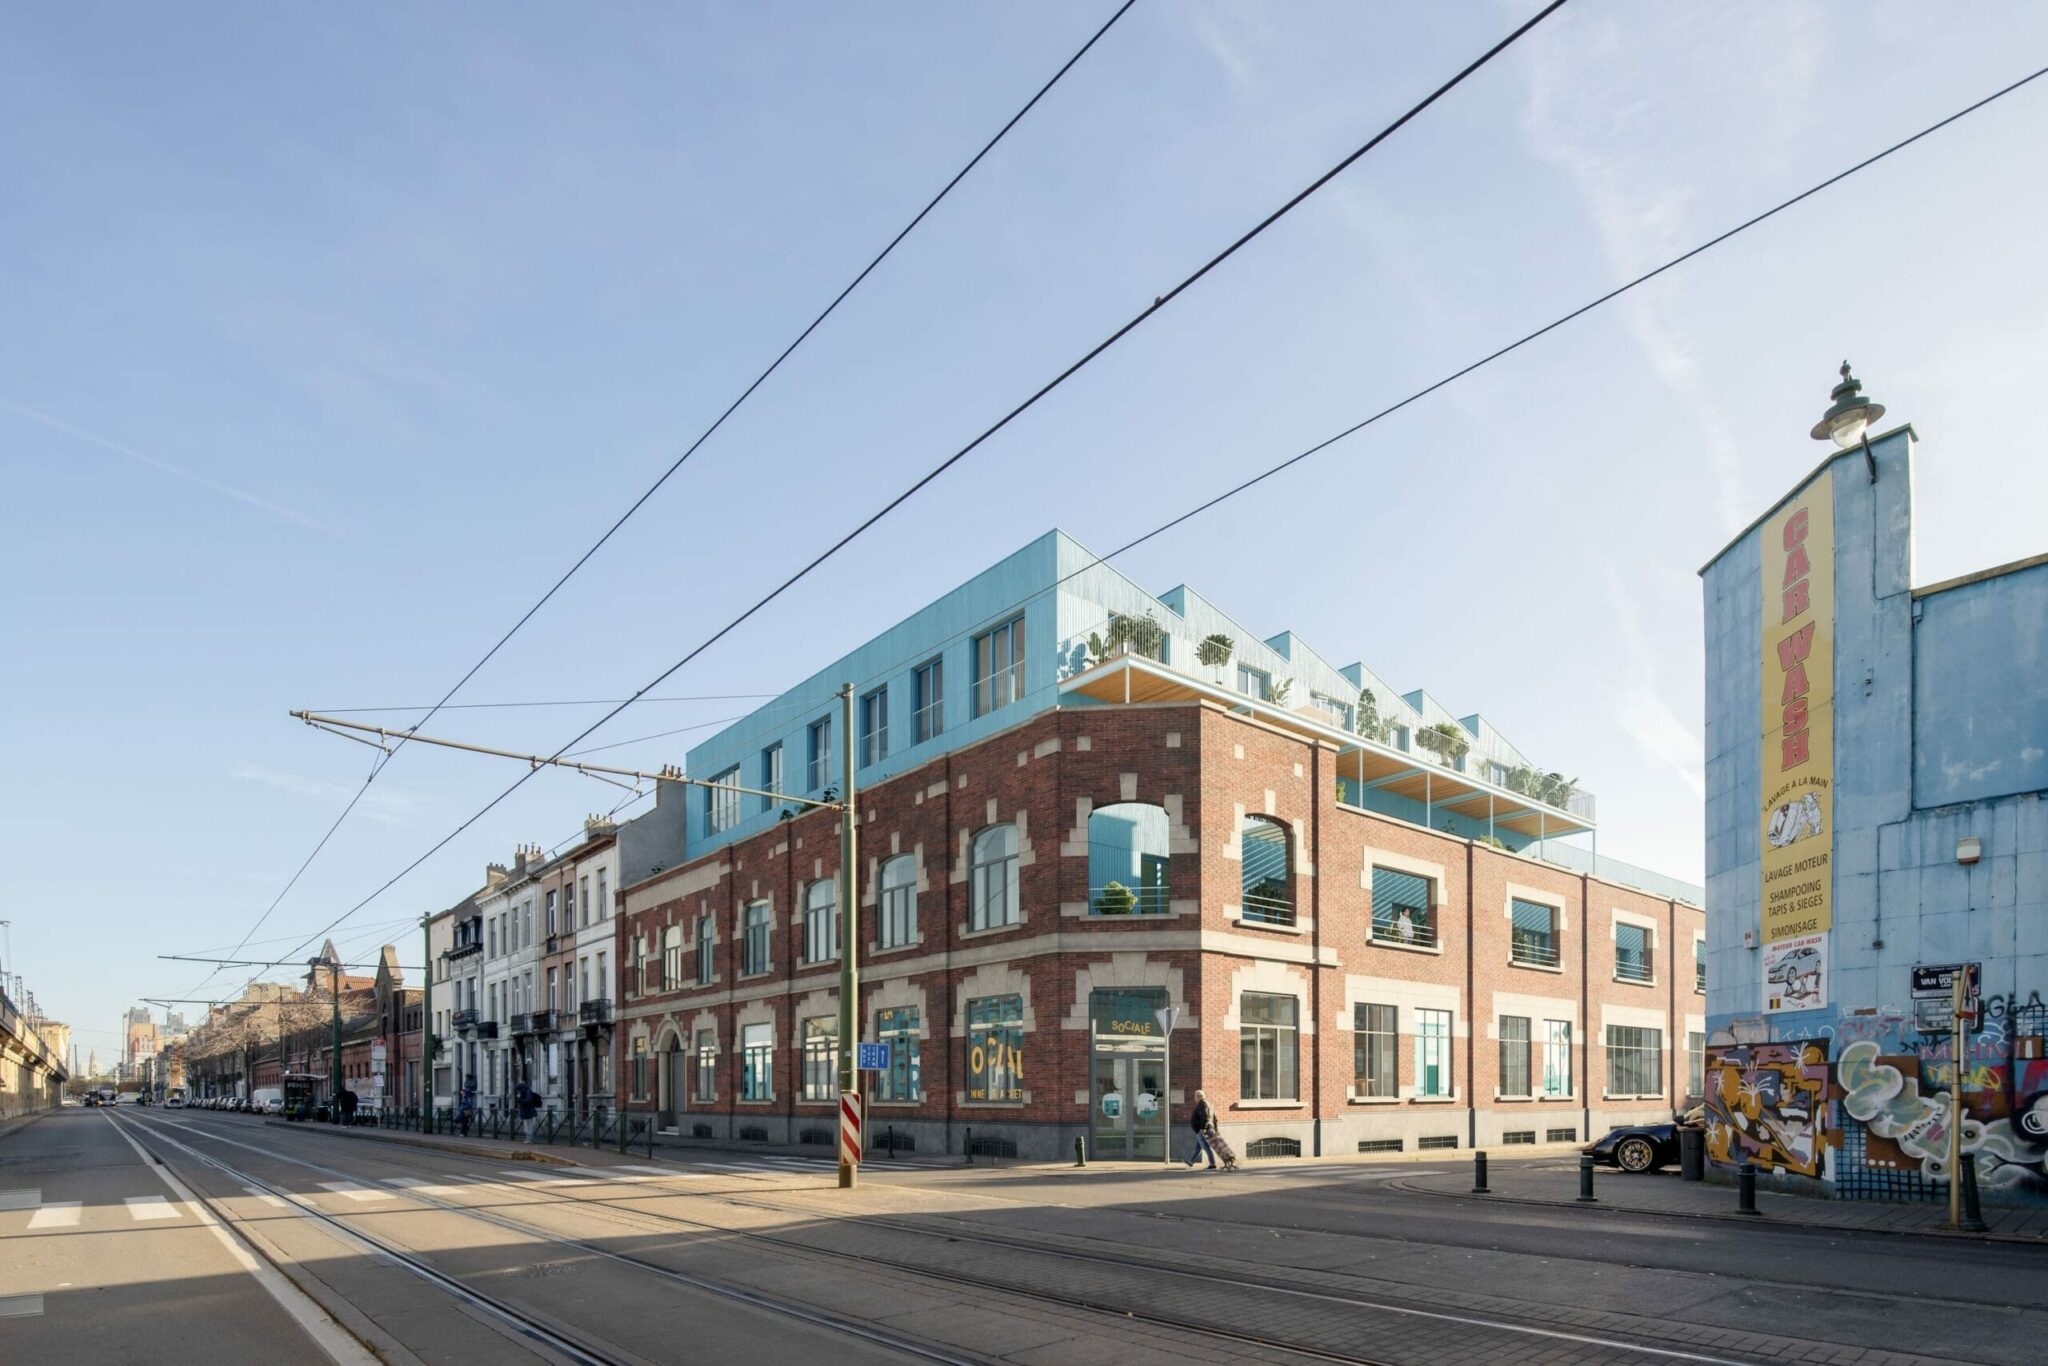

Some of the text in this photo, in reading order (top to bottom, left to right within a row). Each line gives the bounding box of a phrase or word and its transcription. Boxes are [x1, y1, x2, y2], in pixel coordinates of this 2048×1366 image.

[1777, 507, 1815, 772] CAR WASH
[1763, 783, 1791, 812] LAVAGE
[1798, 777, 1808, 787] LA
[1809, 775, 1829, 789] MAIN
[1765, 853, 1828, 883] LAVAGE MOTEUR
[1769, 879, 1822, 904] SHAMPOOING
[1768, 893, 1823, 918] TAPIS & SIEGES
[1771, 918, 1818, 939] SIMONISAGE
[1920, 978, 1937, 986] VAN
[1111, 1020, 1152, 1035] SOCIALE
